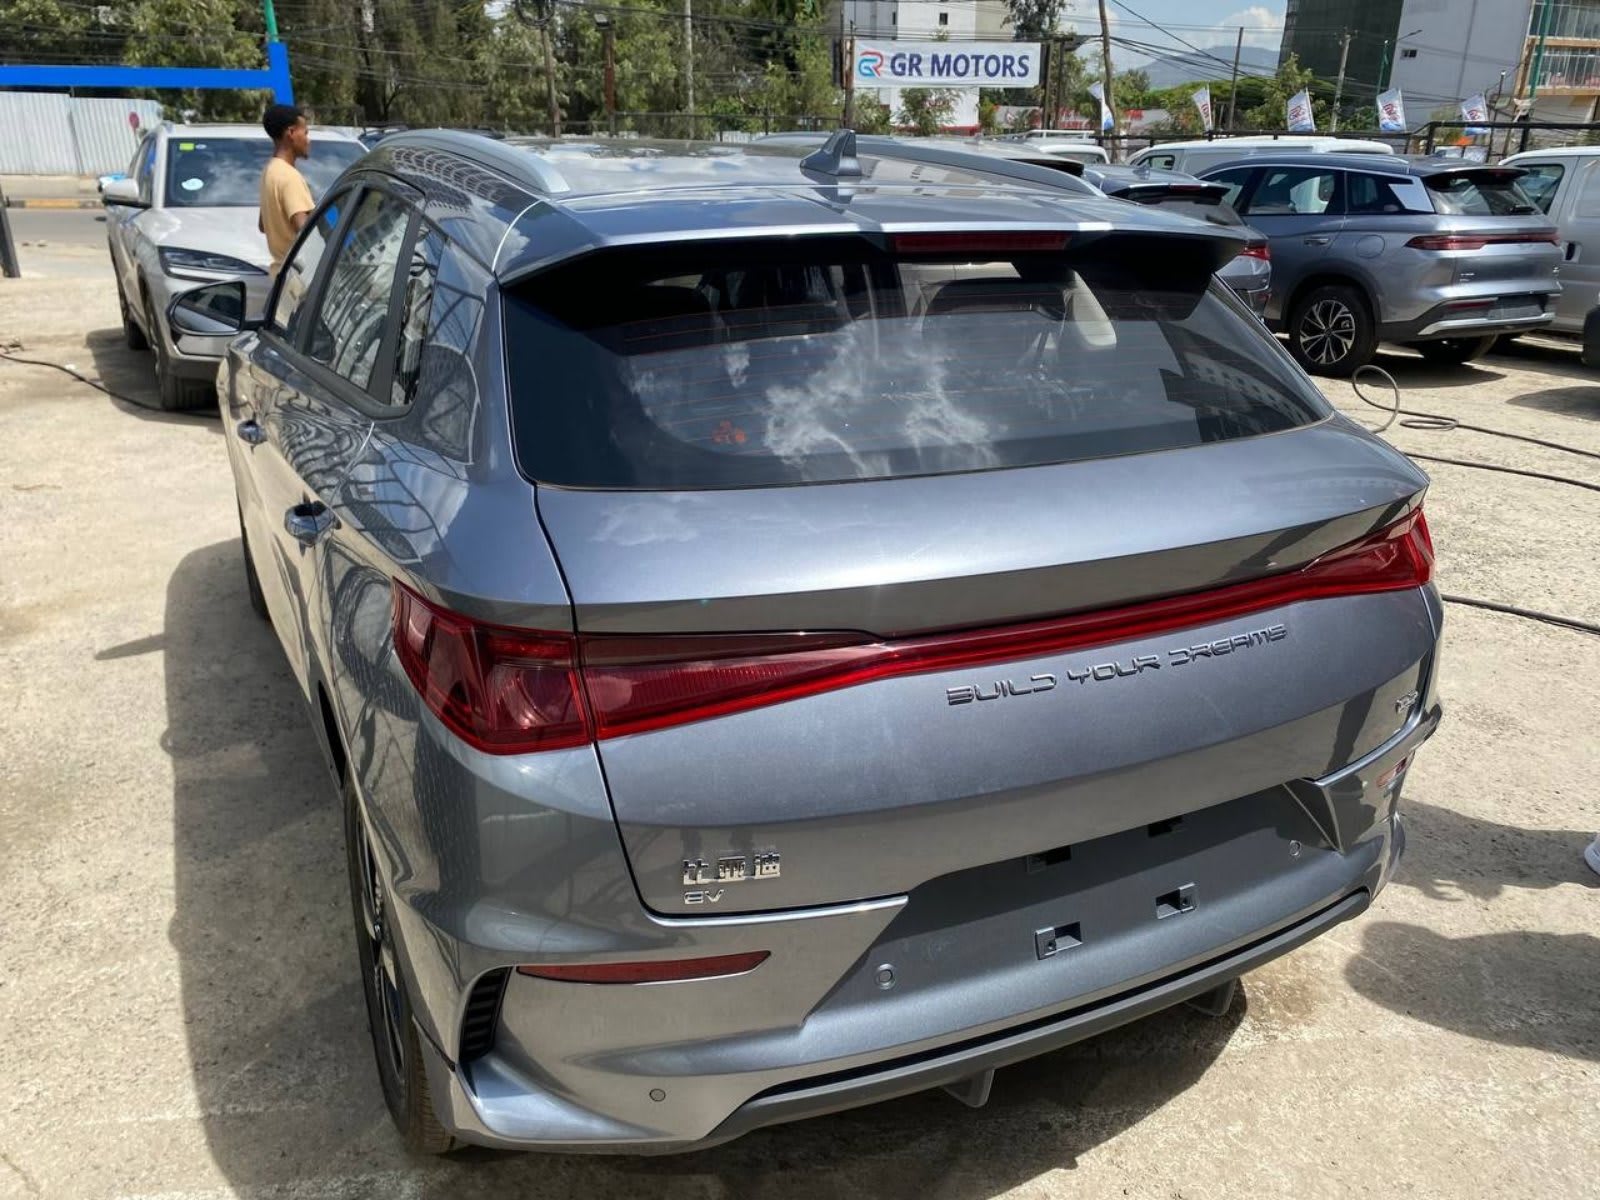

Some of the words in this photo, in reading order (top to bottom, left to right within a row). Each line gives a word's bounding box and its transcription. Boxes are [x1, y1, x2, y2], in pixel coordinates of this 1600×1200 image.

[890, 53, 923, 77] GR
[930, 53, 1030, 78] MOTORS
[946, 673, 1057, 706] BUILD
[1067, 653, 1161, 685] YOUR
[1168, 623, 1287, 666] DREAMS
[683, 852, 780, 885] 比亚迪
